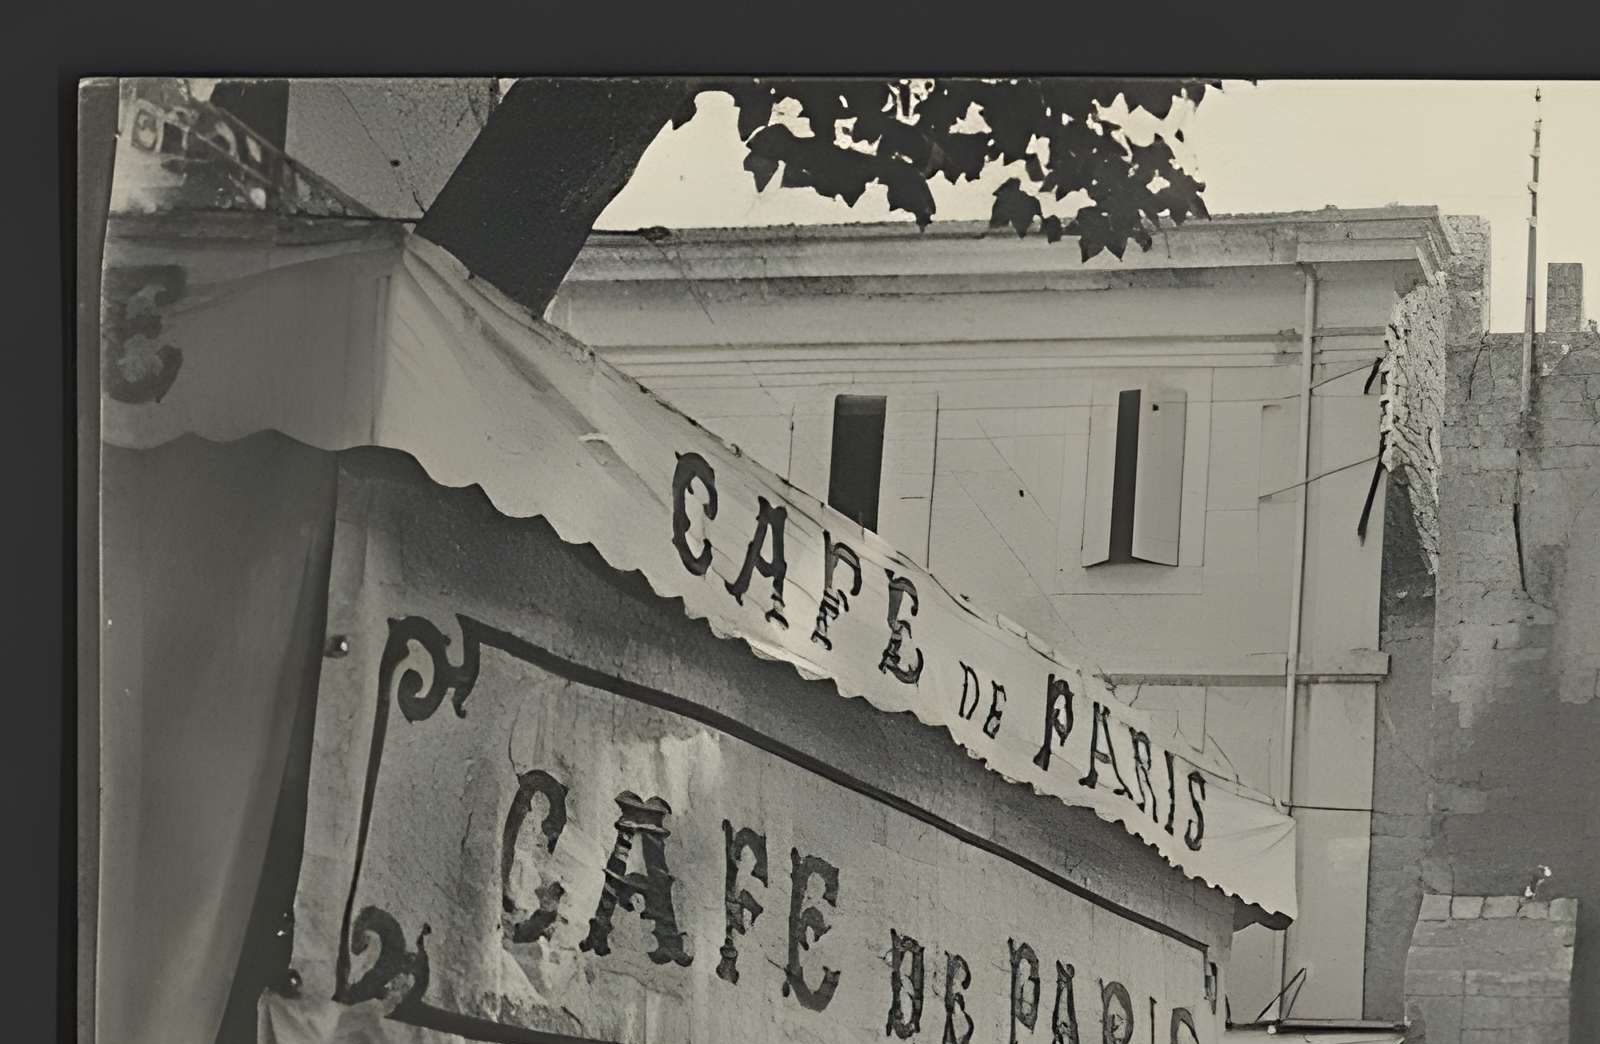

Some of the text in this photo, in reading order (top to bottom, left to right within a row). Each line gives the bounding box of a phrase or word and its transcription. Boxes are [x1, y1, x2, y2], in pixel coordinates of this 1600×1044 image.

[672, 451, 1206, 851] CAFE DE PARIS
[500, 768, 842, 1013] CAFE
